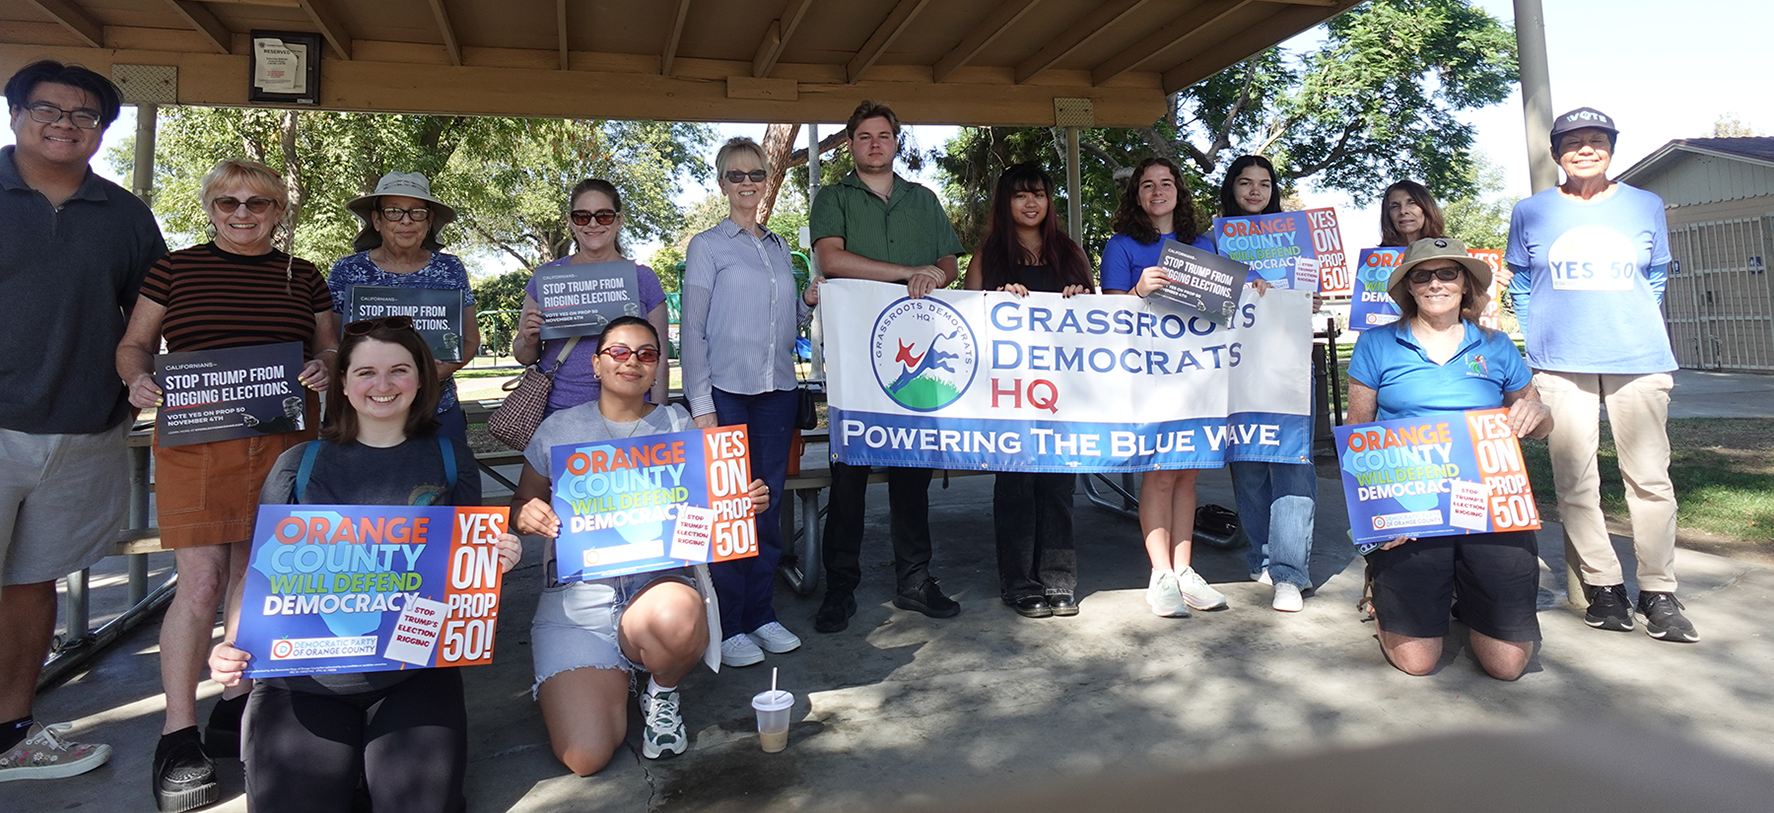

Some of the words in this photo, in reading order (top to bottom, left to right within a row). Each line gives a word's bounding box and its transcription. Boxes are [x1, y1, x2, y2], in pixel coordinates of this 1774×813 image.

[1223, 217, 1296, 237] ORANGE
[1308, 210, 1336, 229] YES
[1226, 231, 1296, 251] COUNTY
[1313, 228, 1341, 252] ON
[1228, 249, 1255, 260] WILL
[1257, 246, 1301, 260] DEFEND
[1243, 255, 1302, 271] MOCRACY
[1318, 253, 1347, 268] PROP.
[1164, 255, 1184, 270] STOP
[1184, 262, 1211, 278] TRUMP
[1210, 271, 1233, 286] FROM
[1322, 266, 1350, 290] 50!
[1551, 261, 1594, 279] YES
[1610, 262, 1634, 279] 50
[543, 283, 566, 295] STOP
[567, 280, 598, 292] TRUMP
[601, 278, 624, 290] FROM
[1190, 277, 1232, 299] ELECTIONS.
[360, 305, 384, 316] STOP
[386, 305, 418, 316] TRUMP
[421, 306, 446, 317] FROM
[544, 294, 580, 308] RIGGING
[581, 290, 630, 304] ELECTIONS.
[876, 302, 923, 358] GRASSROOTS
[929, 304, 972, 364] DEMOCRATS
[991, 302, 1256, 340] GRASSROOS
[992, 340, 1242, 375] DEMOCRATS
[165, 374, 199, 390] STOP
[202, 369, 247, 386] TRUMP
[250, 365, 284, 381] FROM
[166, 390, 219, 407] RIGGING
[222, 381, 292, 401] ELECTIONS.
[992, 378, 1058, 414] HQ
[168, 417, 209, 427] NOVEMBER
[1469, 414, 1511, 440] YES
[707, 430, 746, 460] YES
[842, 419, 1022, 454] POWERING
[1031, 428, 1100, 456] THE
[1111, 430, 1195, 458] BLUE
[1201, 423, 1281, 451] WAVE
[1348, 423, 1452, 452] ORANGE
[567, 441, 685, 475] ORANGE
[1352, 442, 1452, 472] COUNTY
[1477, 438, 1520, 474] ON
[569, 463, 686, 499] COUNTY
[710, 458, 748, 497] ON
[1356, 471, 1394, 487] WILL
[1396, 464, 1459, 482] DEFEND
[1484, 475, 1530, 496] PROP.
[1358, 477, 1461, 501] DEMOCRACY
[1455, 494, 1484, 503] TRUMP'S
[571, 499, 616, 516] WILL
[620, 487, 689, 510] DEFEND
[712, 497, 754, 522] PROP.
[1453, 502, 1485, 510] ELECTION
[1491, 494, 1538, 528] 50!
[570, 502, 689, 534] DEMOCRACY
[680, 521, 708, 530] TRUMP'S
[1455, 510, 1483, 518] RIGGING
[274, 517, 430, 545] ORANGE
[458, 513, 504, 545] YES
[677, 530, 709, 539] ELECTION
[716, 519, 757, 557] 50!
[678, 538, 705, 546] RIGGING
[270, 544, 427, 574] COUNTY
[452, 547, 498, 590] ON
[270, 574, 330, 594] WILL
[333, 572, 423, 592] DEFEND
[263, 592, 420, 616] DEMOCRACY
[414, 606, 435, 616] STOP
[447, 593, 497, 619] PROP.
[398, 625, 436, 638] ELECTION
[404, 614, 438, 628] TRUMP'S
[293, 648, 303, 656] OF
[305, 647, 339, 656] ORANGE
[341, 645, 376, 655] COUNTY
[294, 640, 350, 649] DEMOCRATIC
[352, 638, 376, 646] PARTY
[396, 635, 430, 648] RIGGING
[443, 620, 495, 662] 50!
